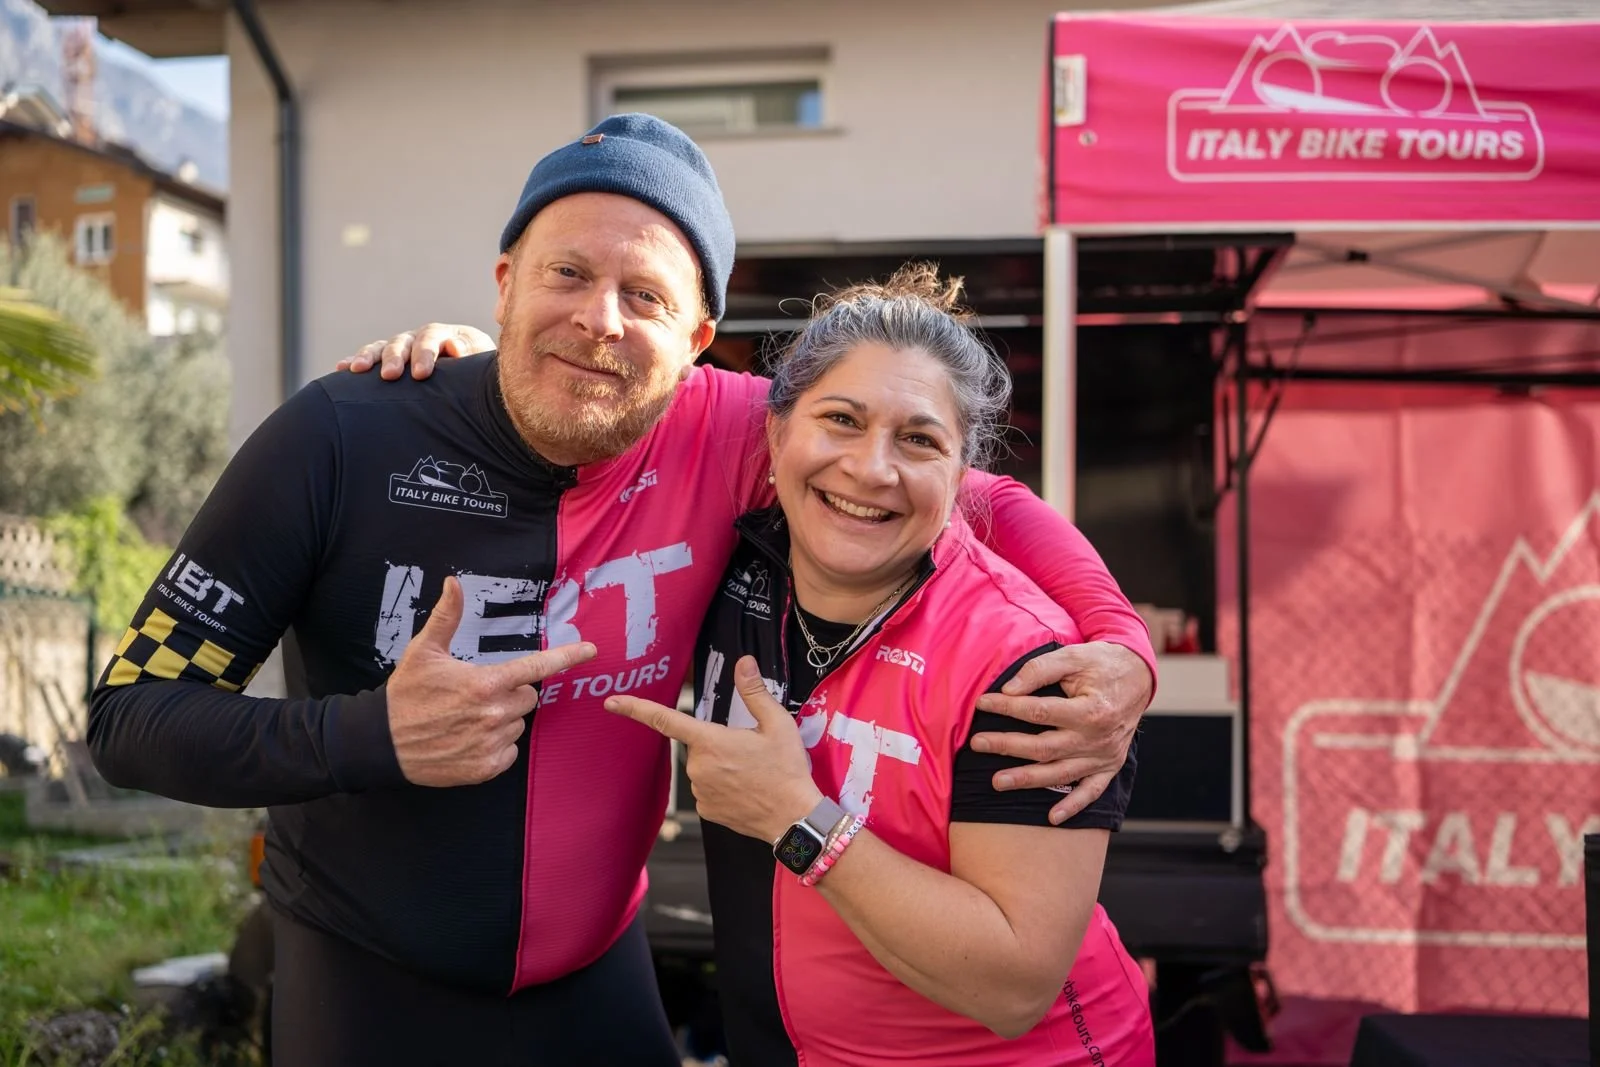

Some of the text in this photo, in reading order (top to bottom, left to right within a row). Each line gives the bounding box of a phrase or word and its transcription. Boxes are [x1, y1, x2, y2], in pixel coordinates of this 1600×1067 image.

[1186, 129, 1525, 161] ITALY BIKE TOURS
[395, 486, 503, 514] ITALY BIKE TOURS
[166, 553, 245, 614] IBT
[374, 541, 693, 670] IBT
[746, 599, 772, 614] TOURS
[157, 583, 228, 634] ITALY BIKE TOURS
[572, 655, 671, 701] TOURS
[1336, 806, 1600, 888] ITALY
